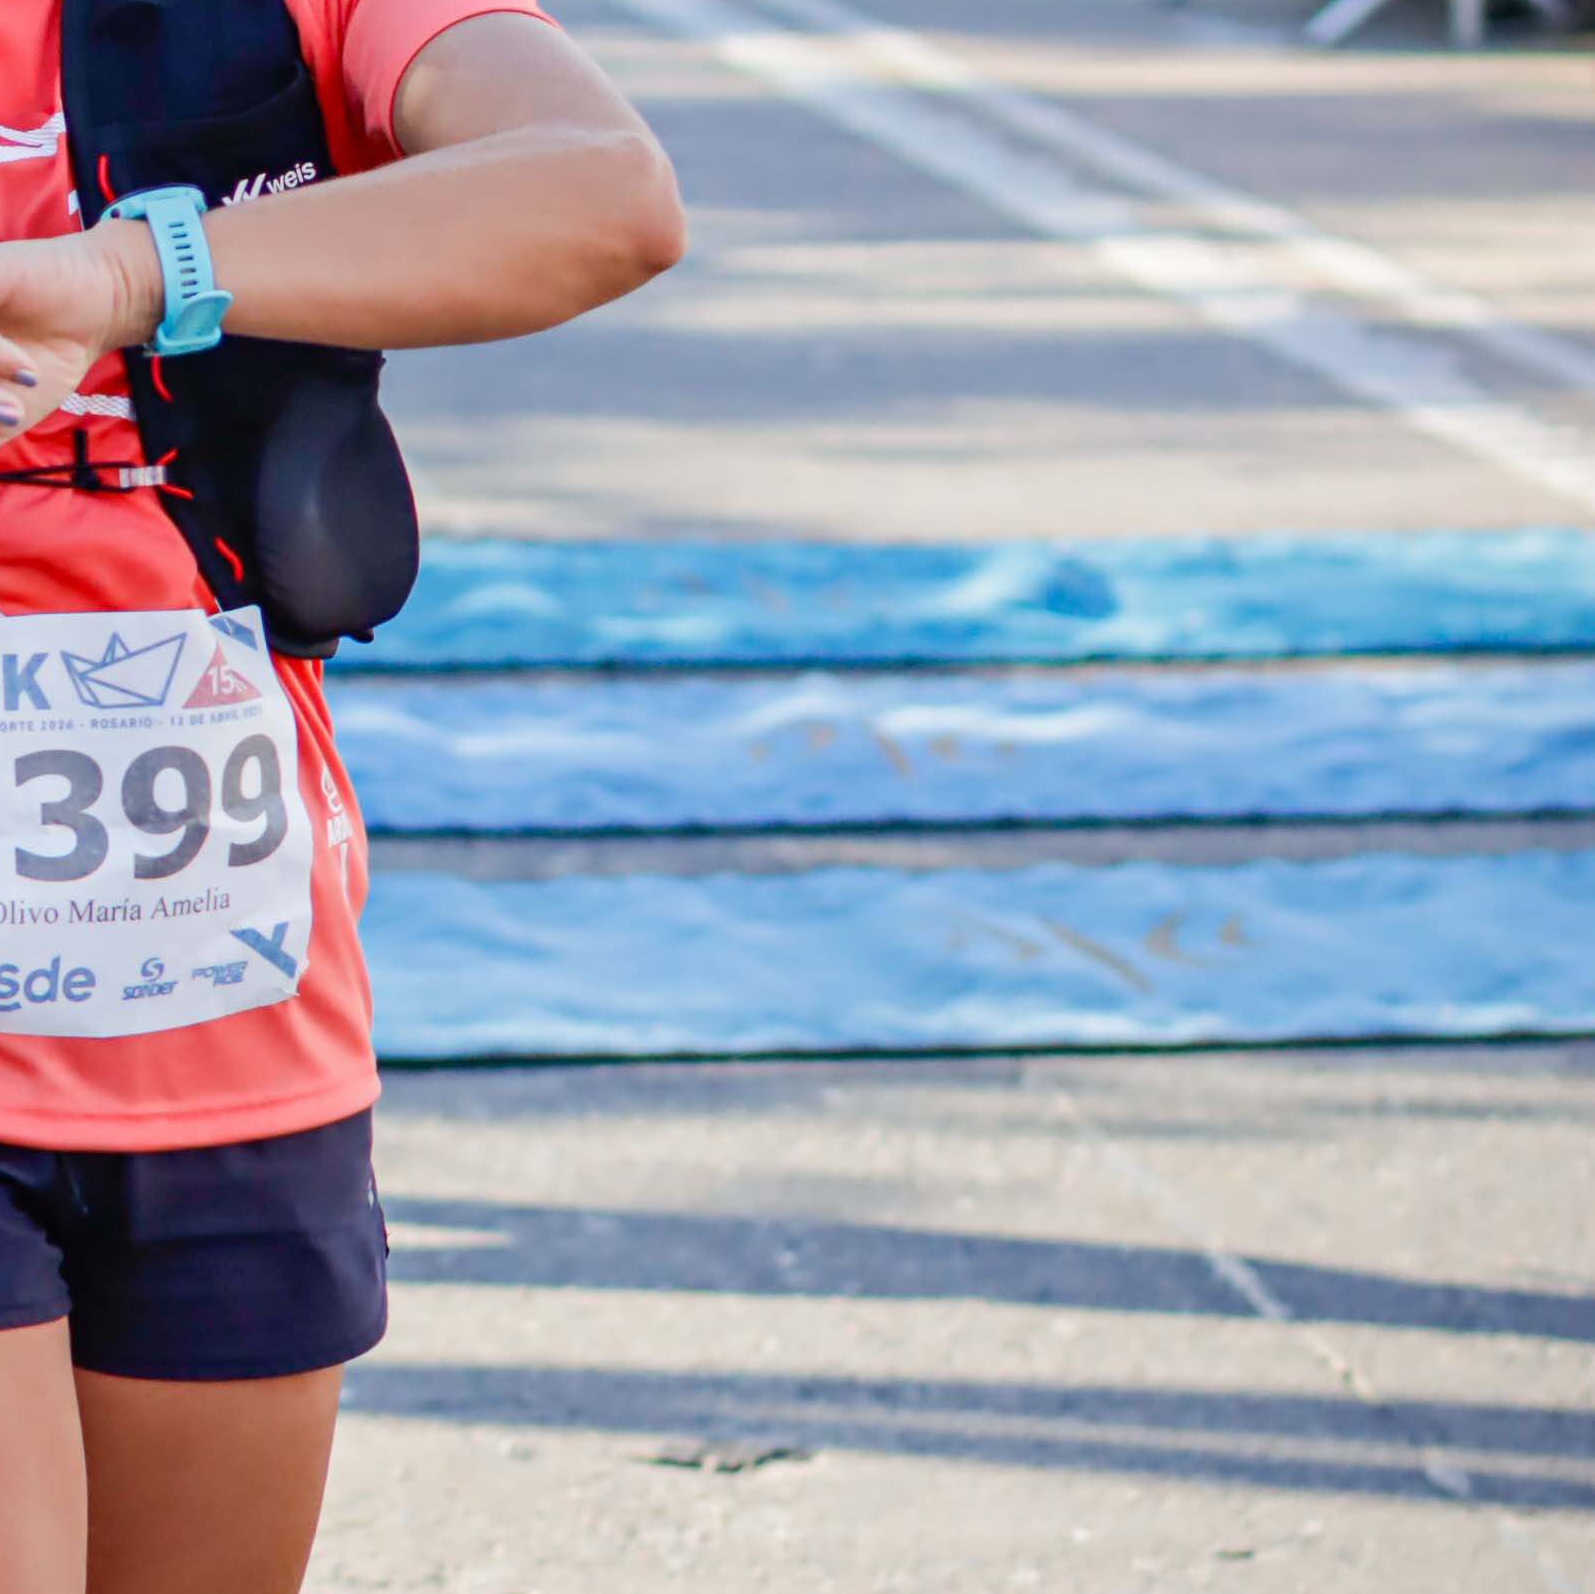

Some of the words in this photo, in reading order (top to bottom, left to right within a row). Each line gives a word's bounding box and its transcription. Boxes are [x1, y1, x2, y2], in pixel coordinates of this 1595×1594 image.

[266, 161, 317, 195] weis
[90, 716, 153, 729] ROSARIO
[190, 714, 204, 726] DE
[66, 897, 143, 925] María
[150, 887, 232, 920] Amelia
